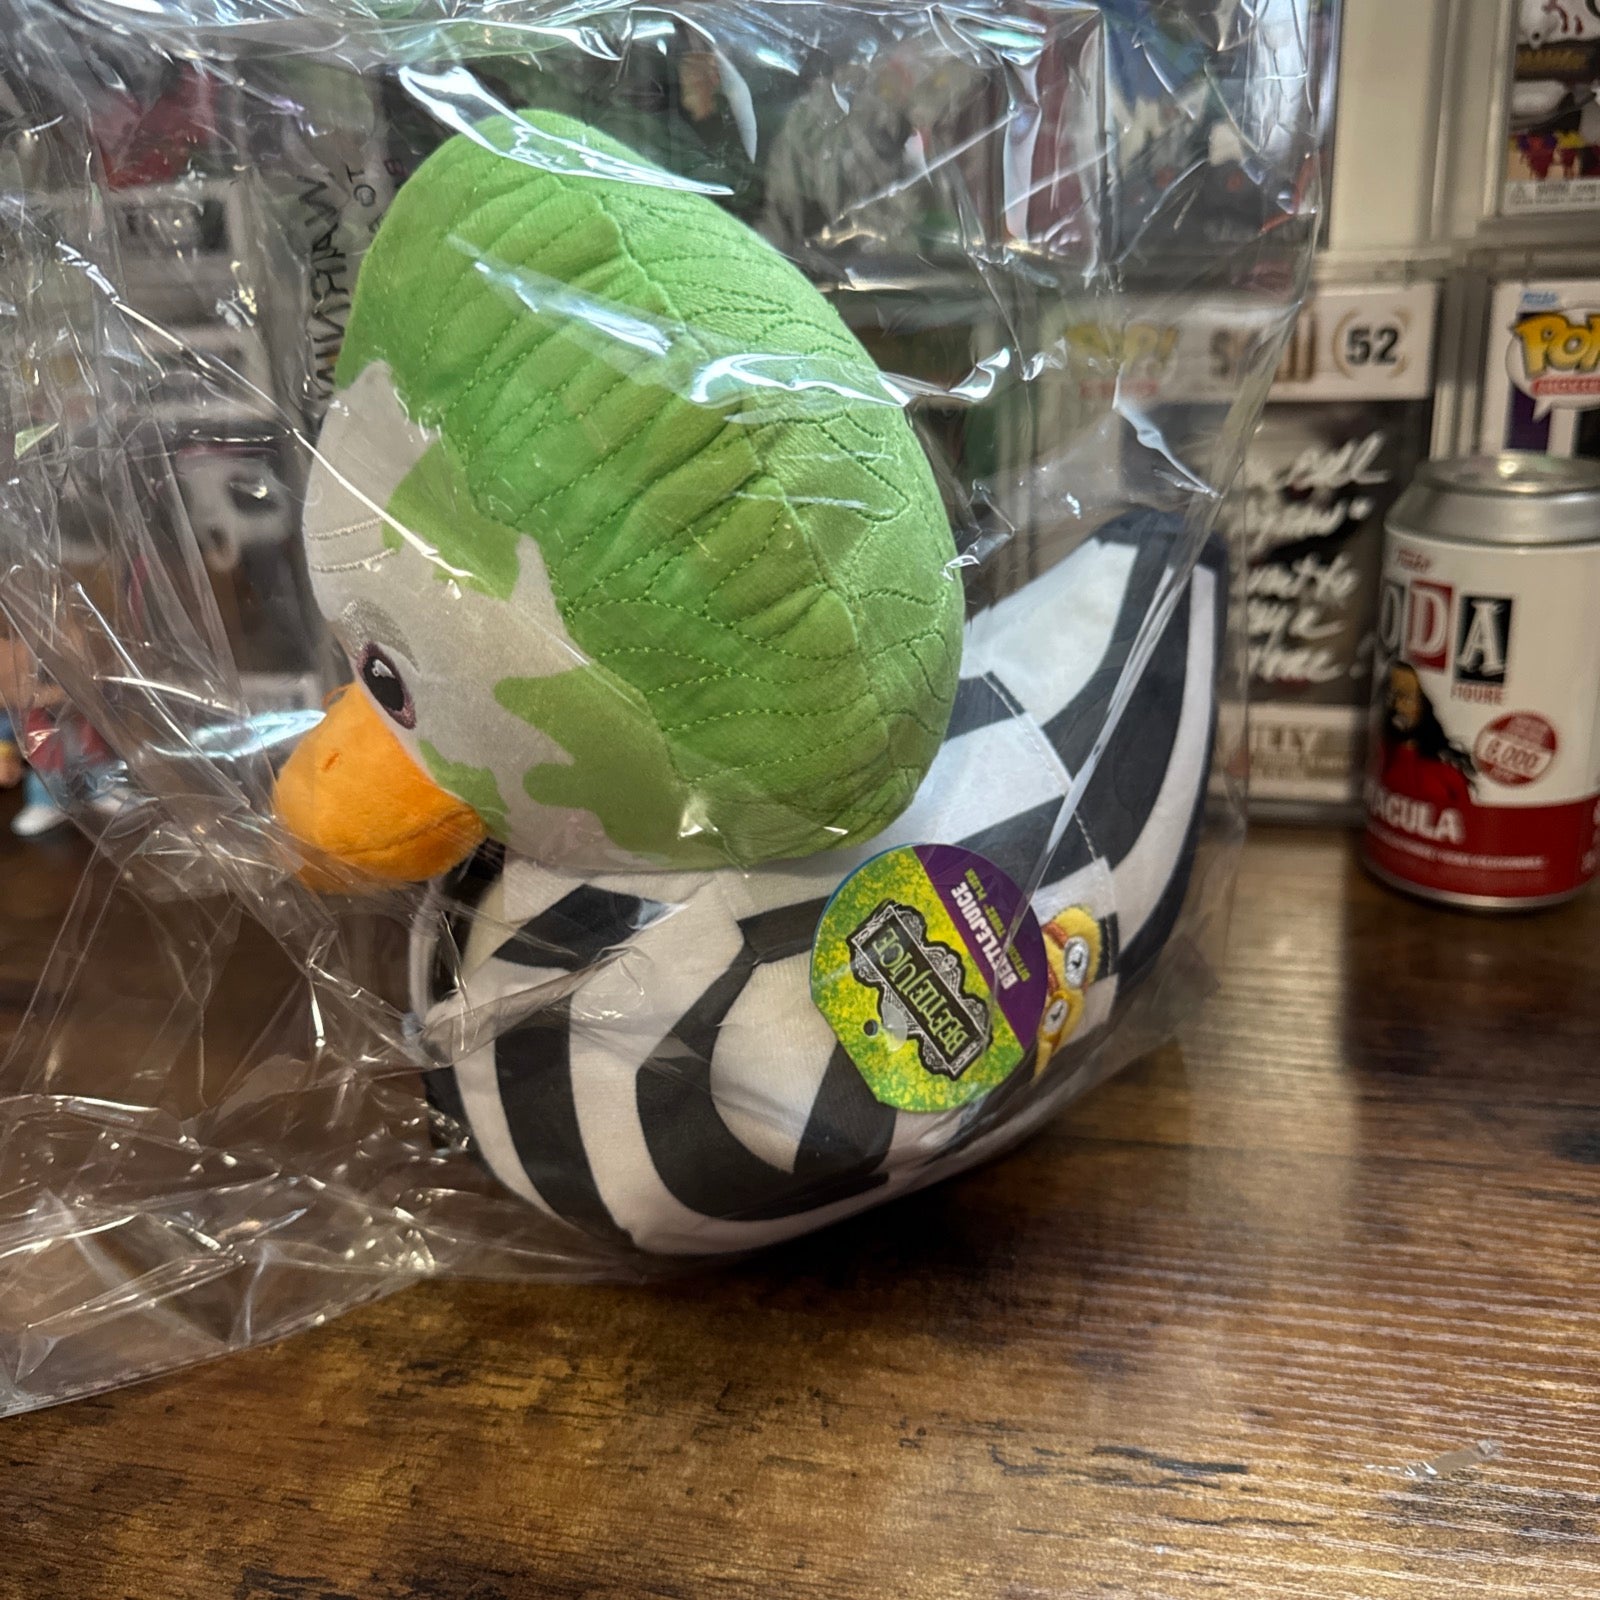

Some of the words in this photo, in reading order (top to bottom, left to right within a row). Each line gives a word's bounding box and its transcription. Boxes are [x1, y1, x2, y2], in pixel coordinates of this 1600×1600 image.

[1346, 327, 1400, 365] 52
[1450, 684, 1503, 705] FIGURE
[950, 881, 1019, 990] BEETLEJUICE
[873, 928, 968, 1055] BEETLEJUICE
